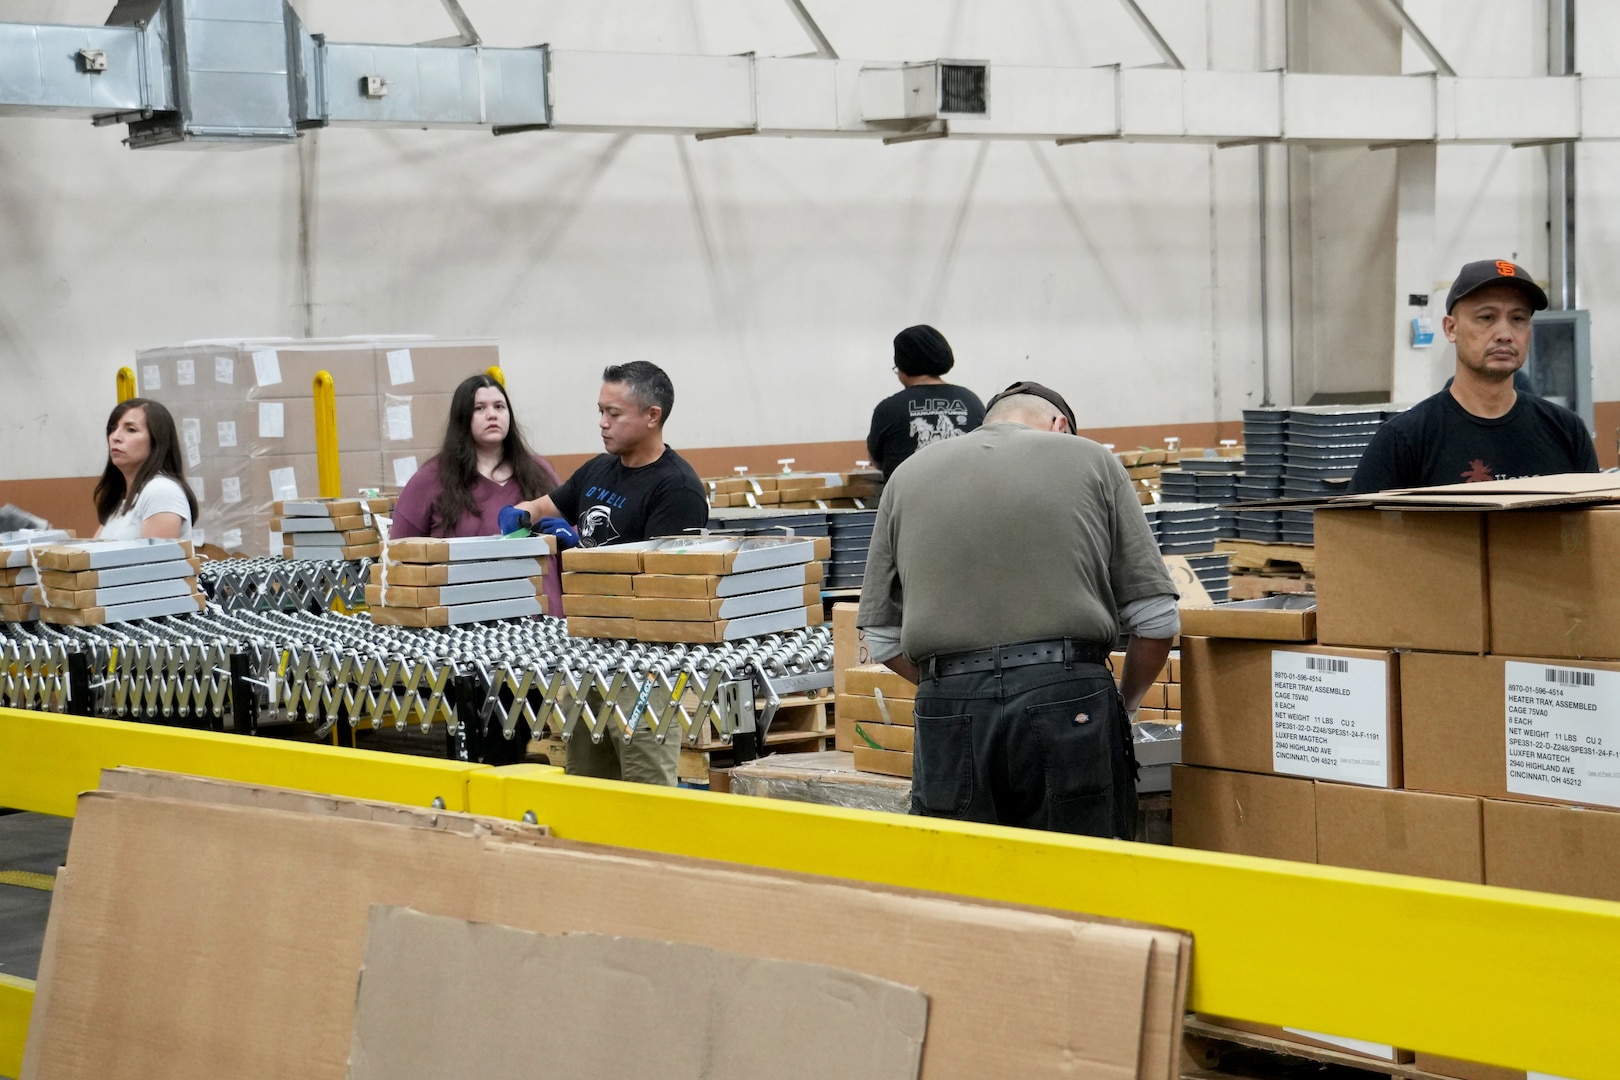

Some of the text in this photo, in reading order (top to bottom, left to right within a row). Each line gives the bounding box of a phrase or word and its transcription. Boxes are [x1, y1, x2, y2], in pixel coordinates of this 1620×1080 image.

[1495, 259, 1517, 277] SF
[909, 398, 968, 411] LIRA
[1275, 672, 1321, 682] 8970-01-596-4514
[1275, 682, 1350, 696] HEATER TRAY, ASSEMBLED
[1509, 684, 1563, 696] 8970-01-596-4514
[1280, 702, 1295, 710] EACH
[1509, 695, 1597, 711] HEATER TRAY, ASSEMBLED
[1509, 706, 1548, 716] CAGE 75VA0
[1276, 732, 1327, 743] LUXFER MAGTECH
[1524, 729, 1549, 738] WEIGHT
[1564, 734, 1577, 742] LBS
[1290, 744, 1319, 753] HIGHLAND
[1509, 739, 1620, 758] SPE3S1-22-D-Z248/SPE3S1-24-F-1
[1276, 752, 1309, 762] CINCINNATI,
[1321, 757, 1337, 765] 45212
[1510, 750, 1570, 763] LUXFER MAGTECH
[1526, 762, 1560, 772] HIGHLAND
[1510, 771, 1549, 783] CINCINNATI,
[1563, 777, 1581, 786] 45212
